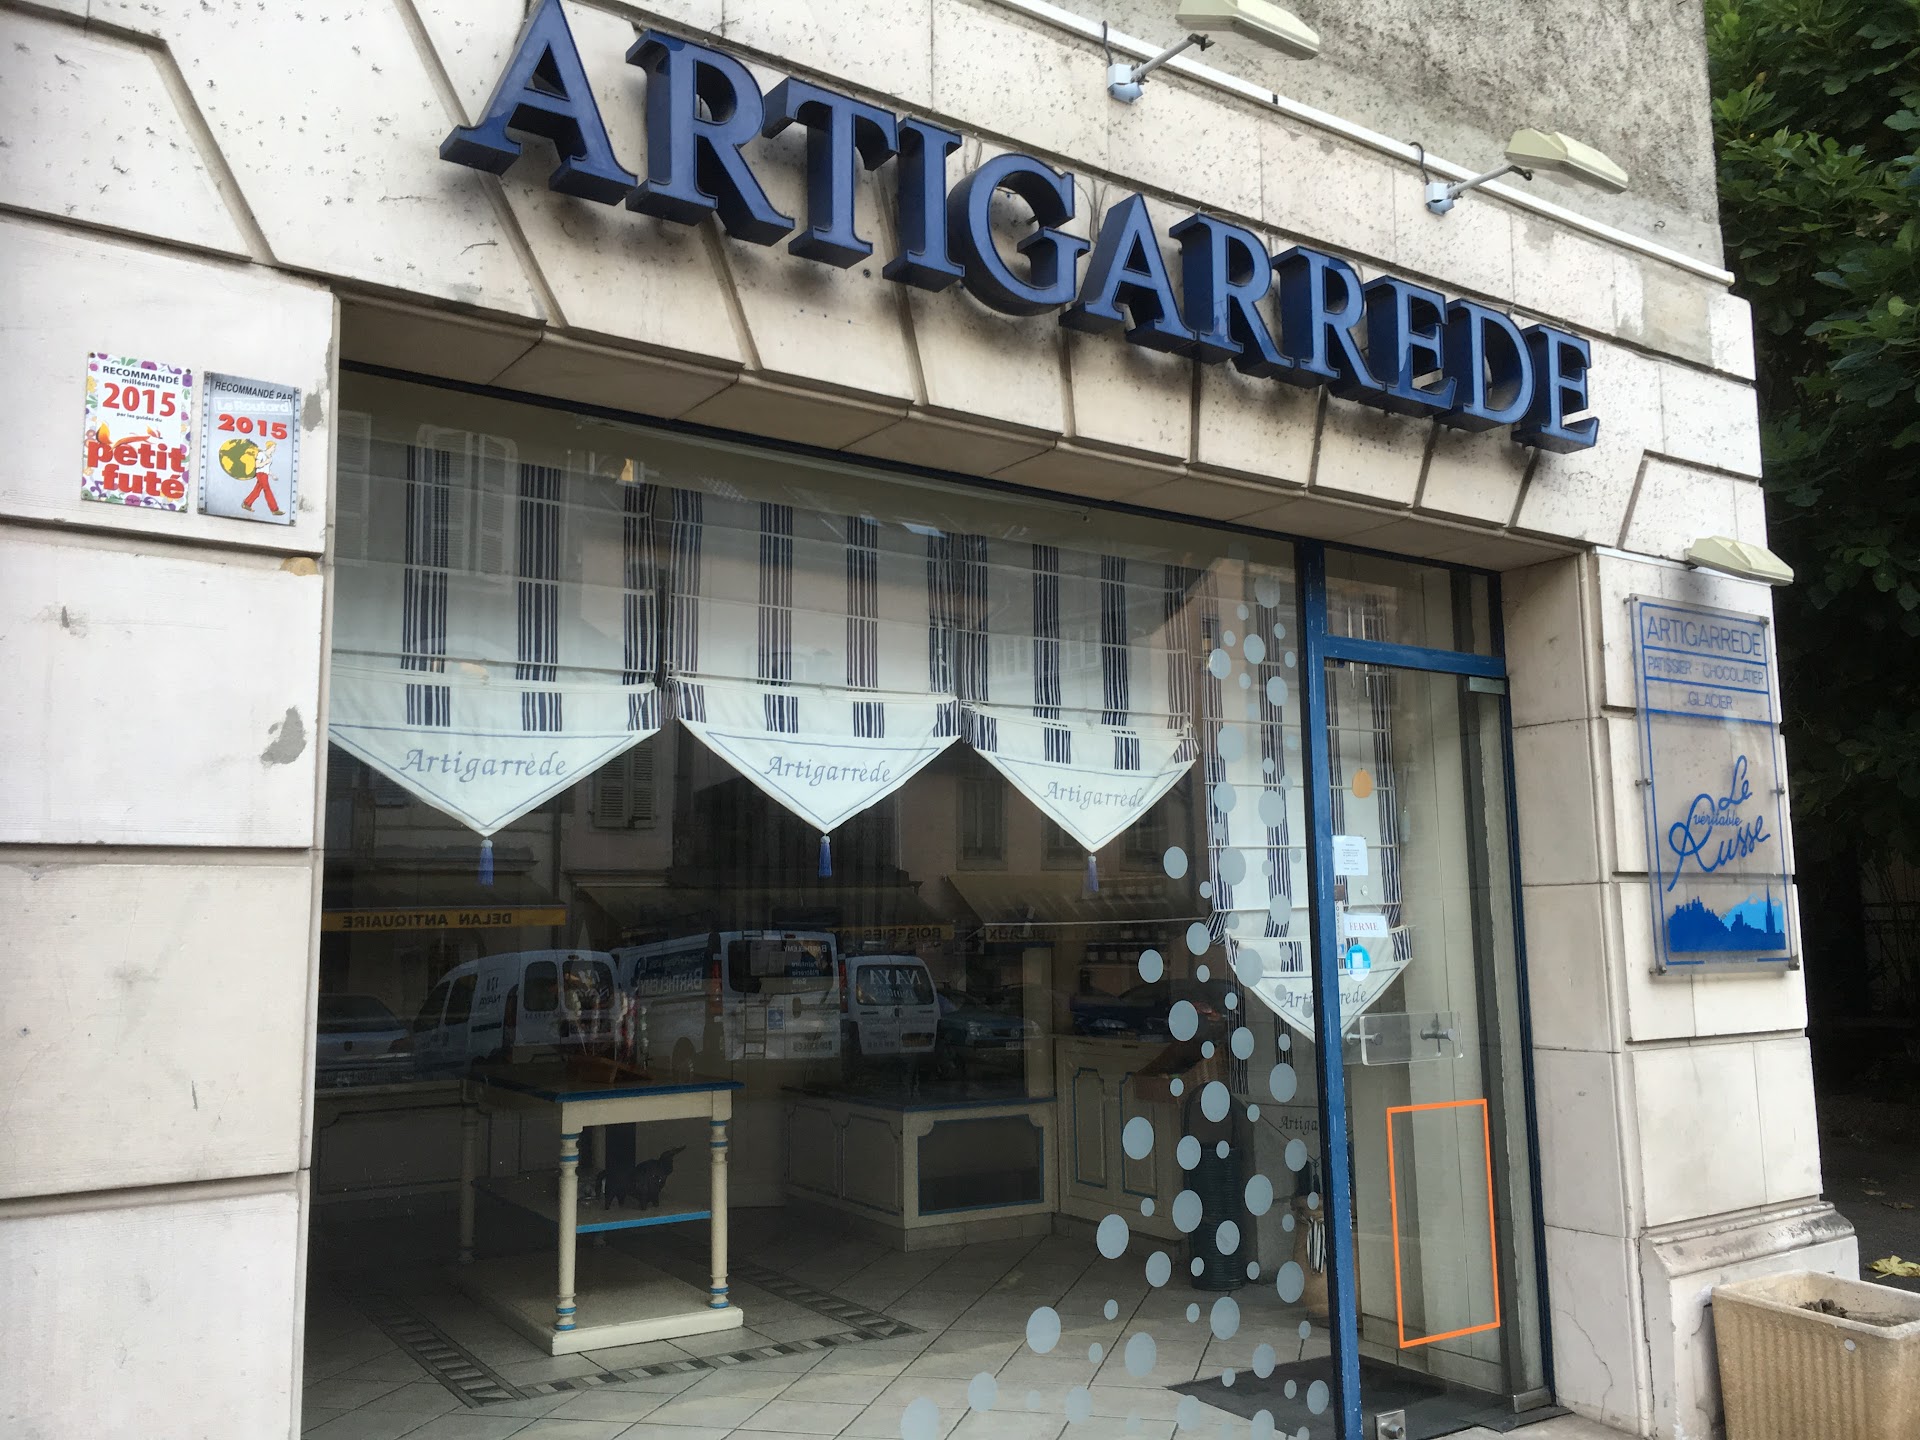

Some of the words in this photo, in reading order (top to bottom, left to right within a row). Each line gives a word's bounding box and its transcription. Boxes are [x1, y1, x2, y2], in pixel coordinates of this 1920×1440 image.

[440, 0, 1600, 455] ARTIGARREDE
[102, 365, 180, 386] RECOMMANDÉ
[121, 377, 161, 389] millésime
[101, 382, 176, 417] 2015
[214, 381, 275, 400] RECOMMANDÉ
[275, 391, 293, 402] PAR
[216, 399, 234, 411] Le
[234, 401, 289, 413] Routard
[217, 413, 288, 440] 2015
[86, 440, 186, 473] petit
[101, 463, 186, 500] futé
[1647, 616, 1762, 657] ARTIGARREDE
[1688, 691, 1733, 710] GLACIER
[401, 748, 568, 783] Artigarrède
[763, 755, 891, 786] Artigarrède
[1043, 780, 1145, 811] Artigarrède
[1718, 755, 1753, 811] Le
[1693, 809, 1743, 827] véritable
[1667, 793, 1771, 892] Russe
[1279, 1115, 1319, 1136] Artiga
